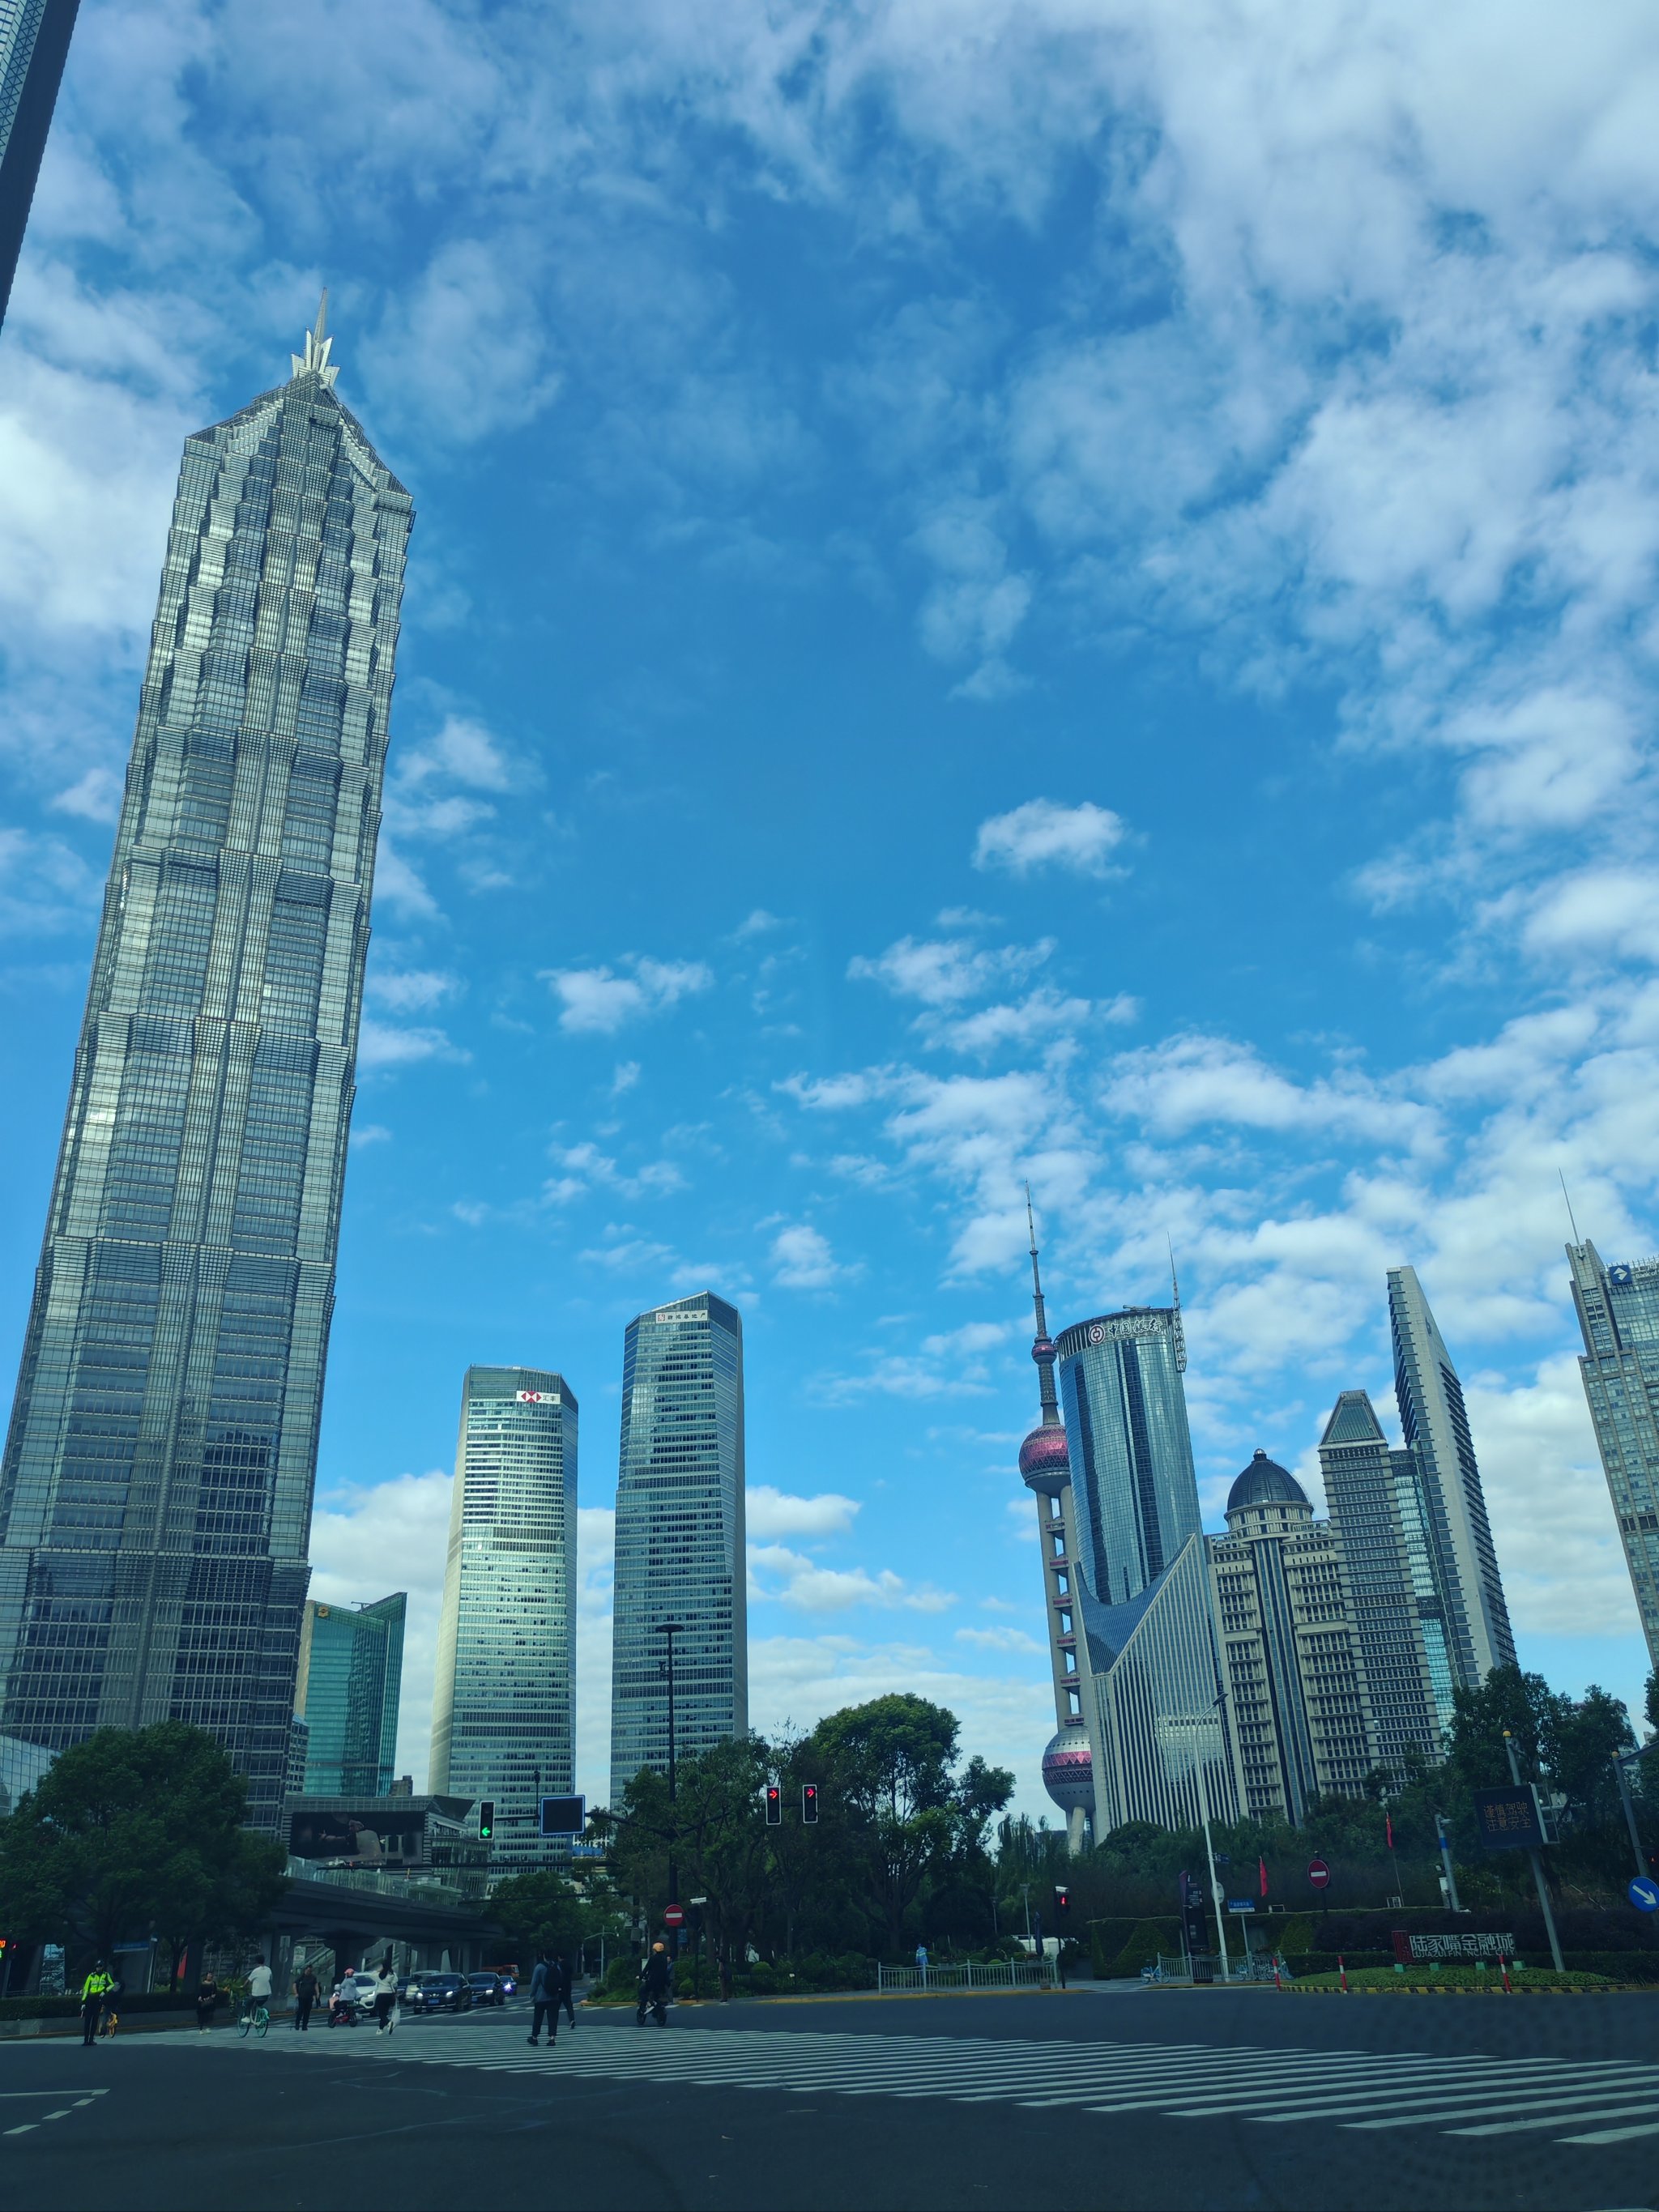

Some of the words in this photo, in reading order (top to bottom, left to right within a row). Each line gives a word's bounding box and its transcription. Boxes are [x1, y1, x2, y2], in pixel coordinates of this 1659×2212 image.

[1636, 1272, 1651, 1280] Bank
[1107, 1318, 1162, 1338] 中国银行
[543, 1394, 557, 1402] 汇丰
[1483, 1801, 1529, 1818] 谨慎驾驶
[1486, 1816, 1531, 1832] 注意安全
[1409, 1933, 1516, 1954] 陆家嘴金融城
